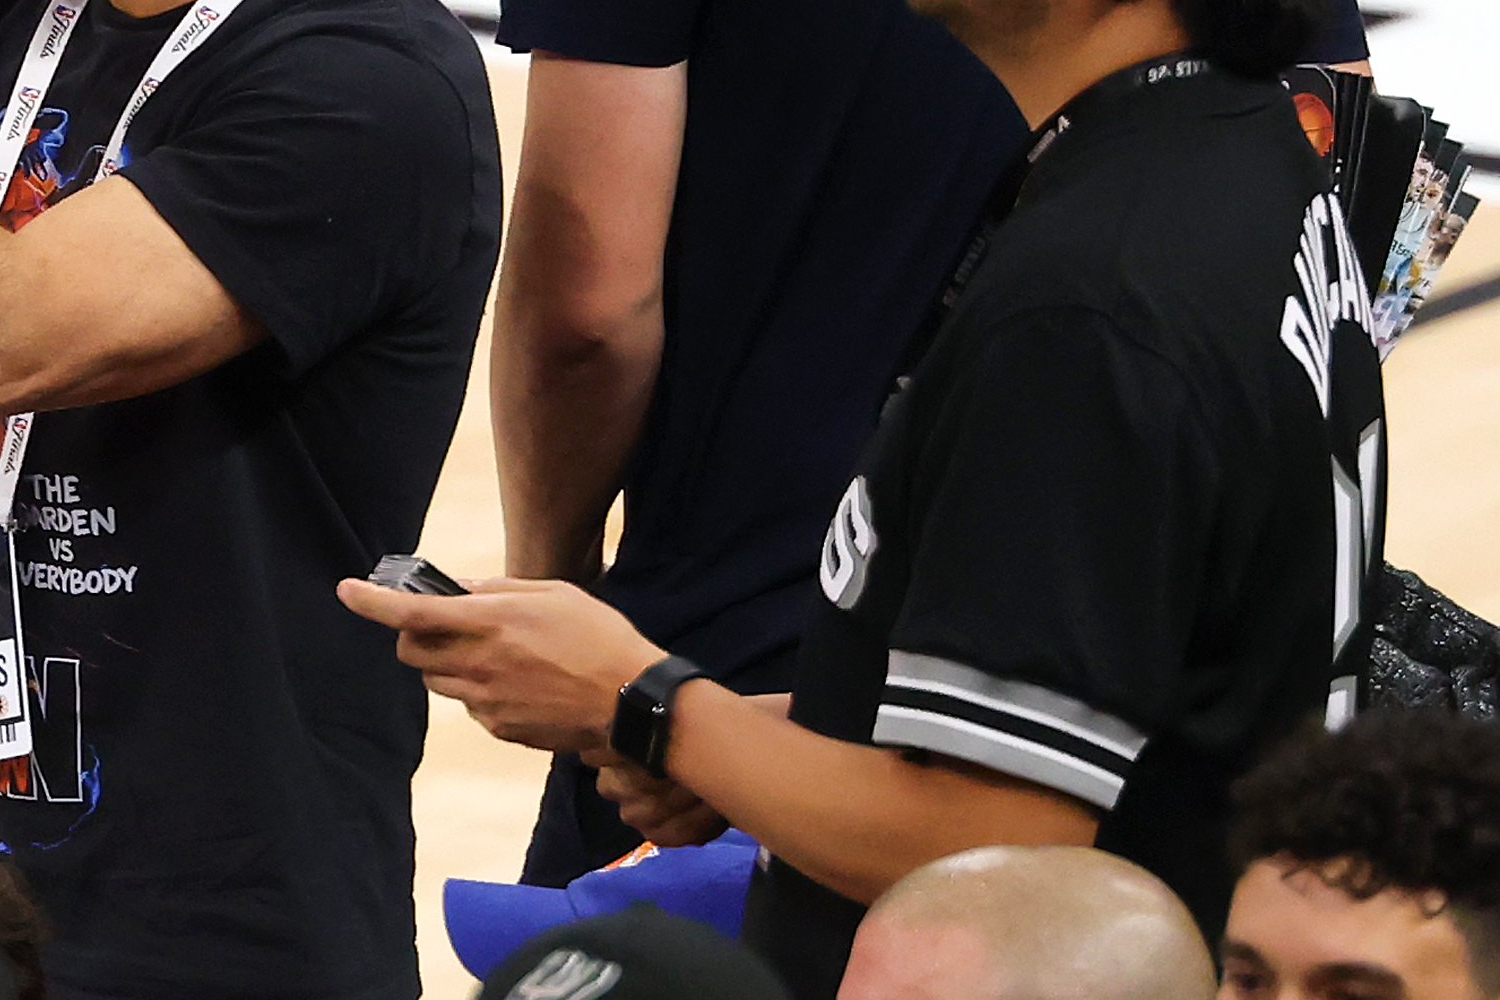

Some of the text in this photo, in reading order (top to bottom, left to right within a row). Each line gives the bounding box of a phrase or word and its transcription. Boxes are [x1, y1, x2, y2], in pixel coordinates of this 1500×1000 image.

[25, 473, 81, 504] THE
[49, 538, 75, 562] VS
[18, 561, 138, 595] VERYBODY
